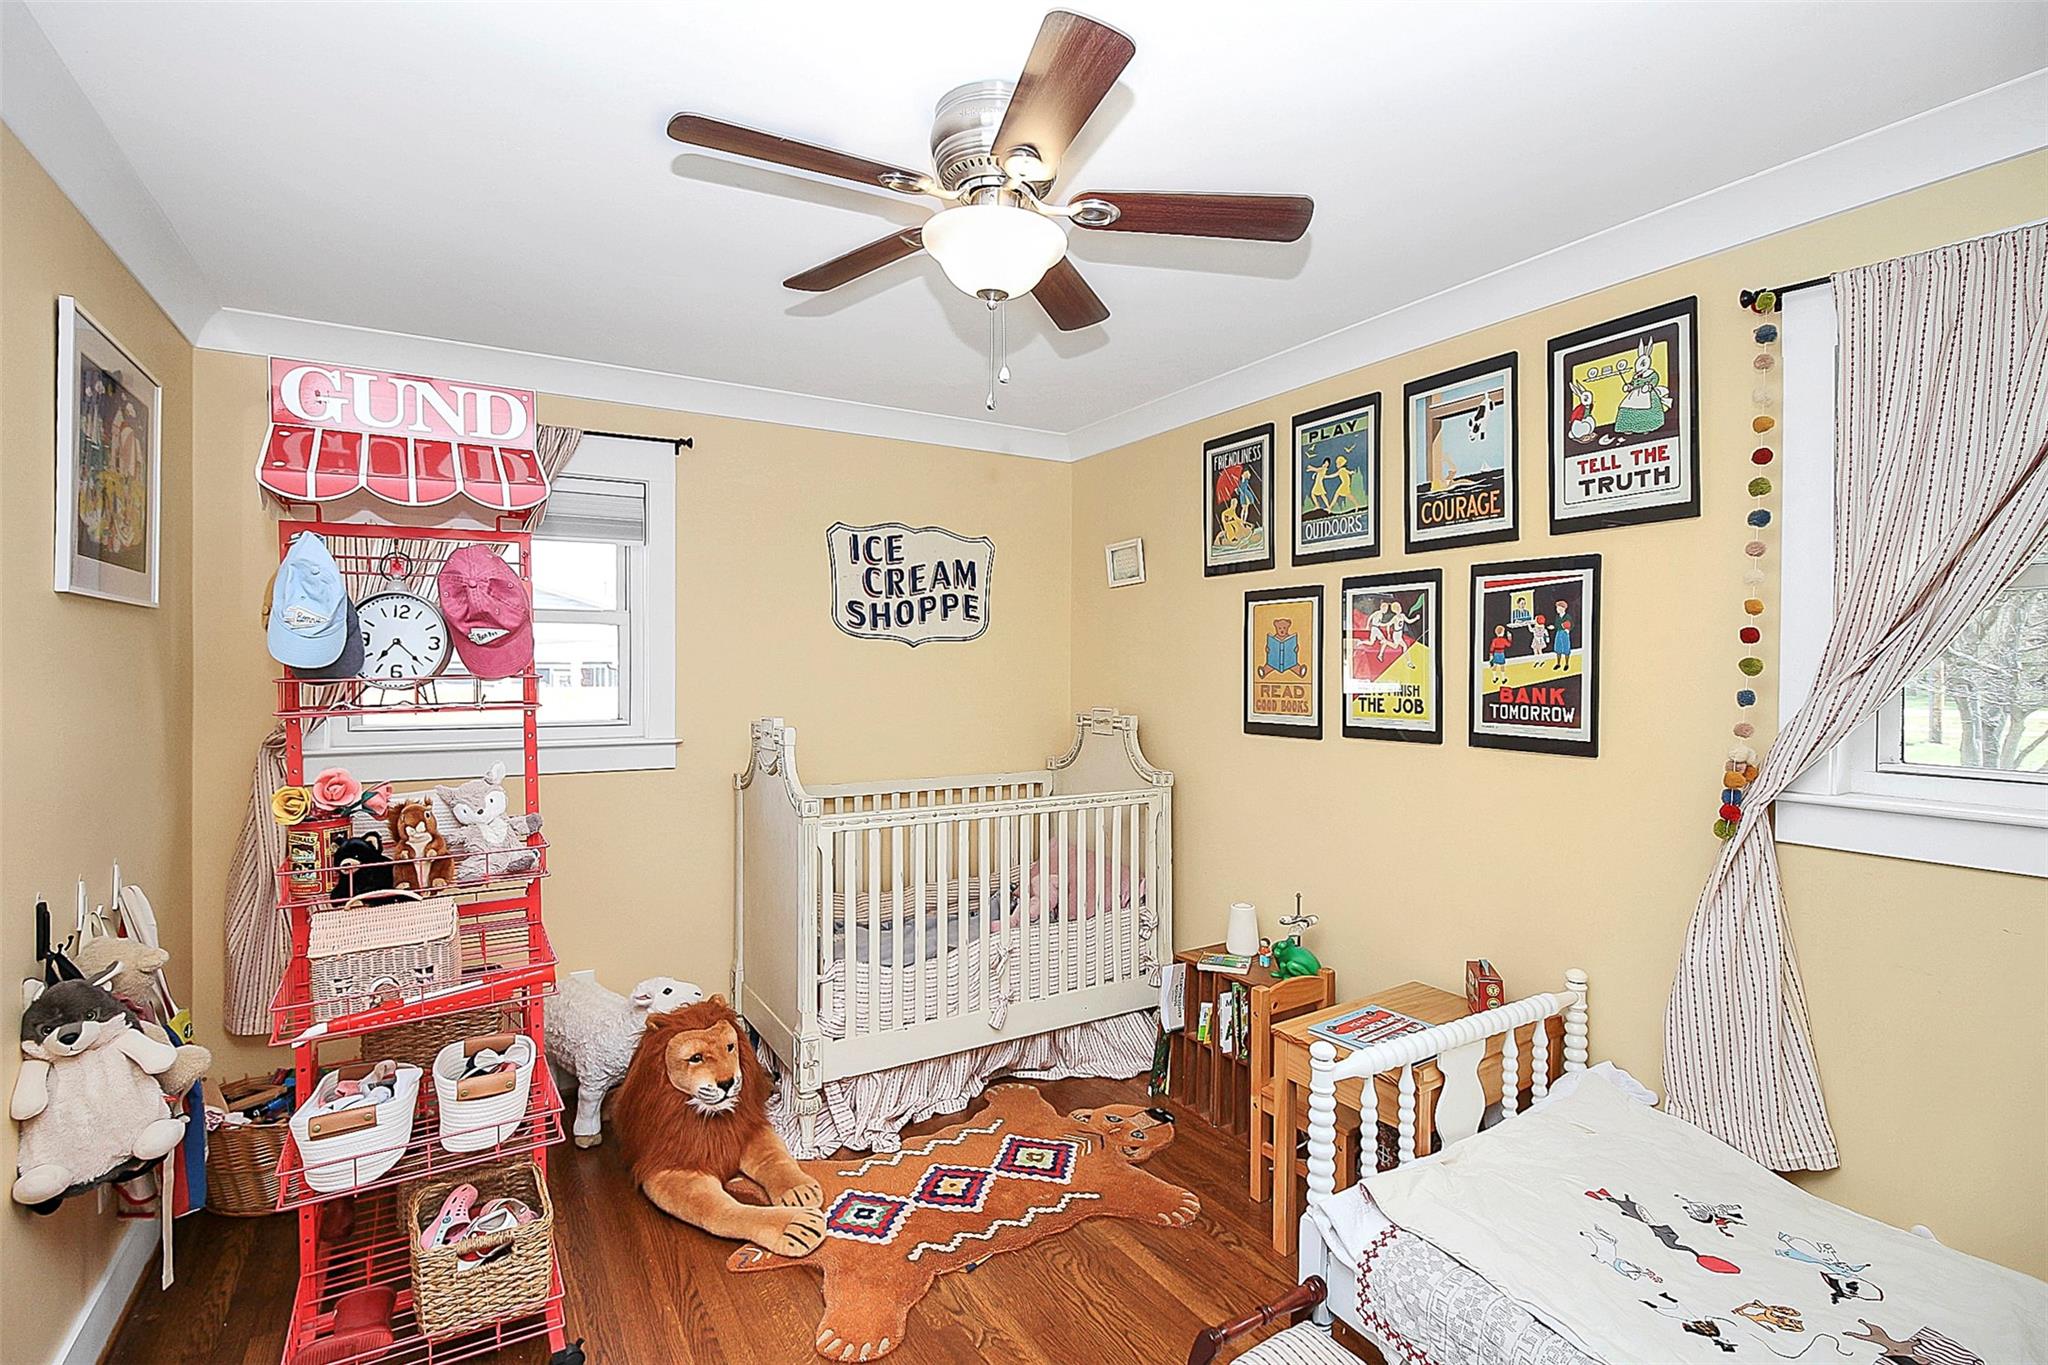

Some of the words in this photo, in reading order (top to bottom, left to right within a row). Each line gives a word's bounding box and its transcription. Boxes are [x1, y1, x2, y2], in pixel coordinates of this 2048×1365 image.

[280, 365, 528, 441] GUND
[1308, 420, 1358, 443] PLAY
[1213, 445, 1262, 472] FRIENDLINESS
[1577, 454, 1622, 475] TELL
[1630, 444, 1671, 466] THE
[1578, 466, 1671, 497] TRUTH
[1421, 490, 1501, 524] COURAGE
[1305, 514, 1362, 540] OUTDOORS
[849, 533, 905, 566] ICE
[862, 558, 977, 599] CREAM
[393, 604, 410, 620] 12
[846, 593, 981, 630] SHOPPE
[428, 636, 441, 651] 3
[390, 663, 403, 679] 6
[1260, 684, 1305, 699] READ
[1499, 686, 1566, 706] BANK
[1255, 700, 1277, 712] GOOD
[1281, 700, 1309, 713] BOOKS
[1358, 697, 1385, 713] THE
[1393, 698, 1424, 715] JOB
[1489, 703, 1576, 723] TOMORROW
